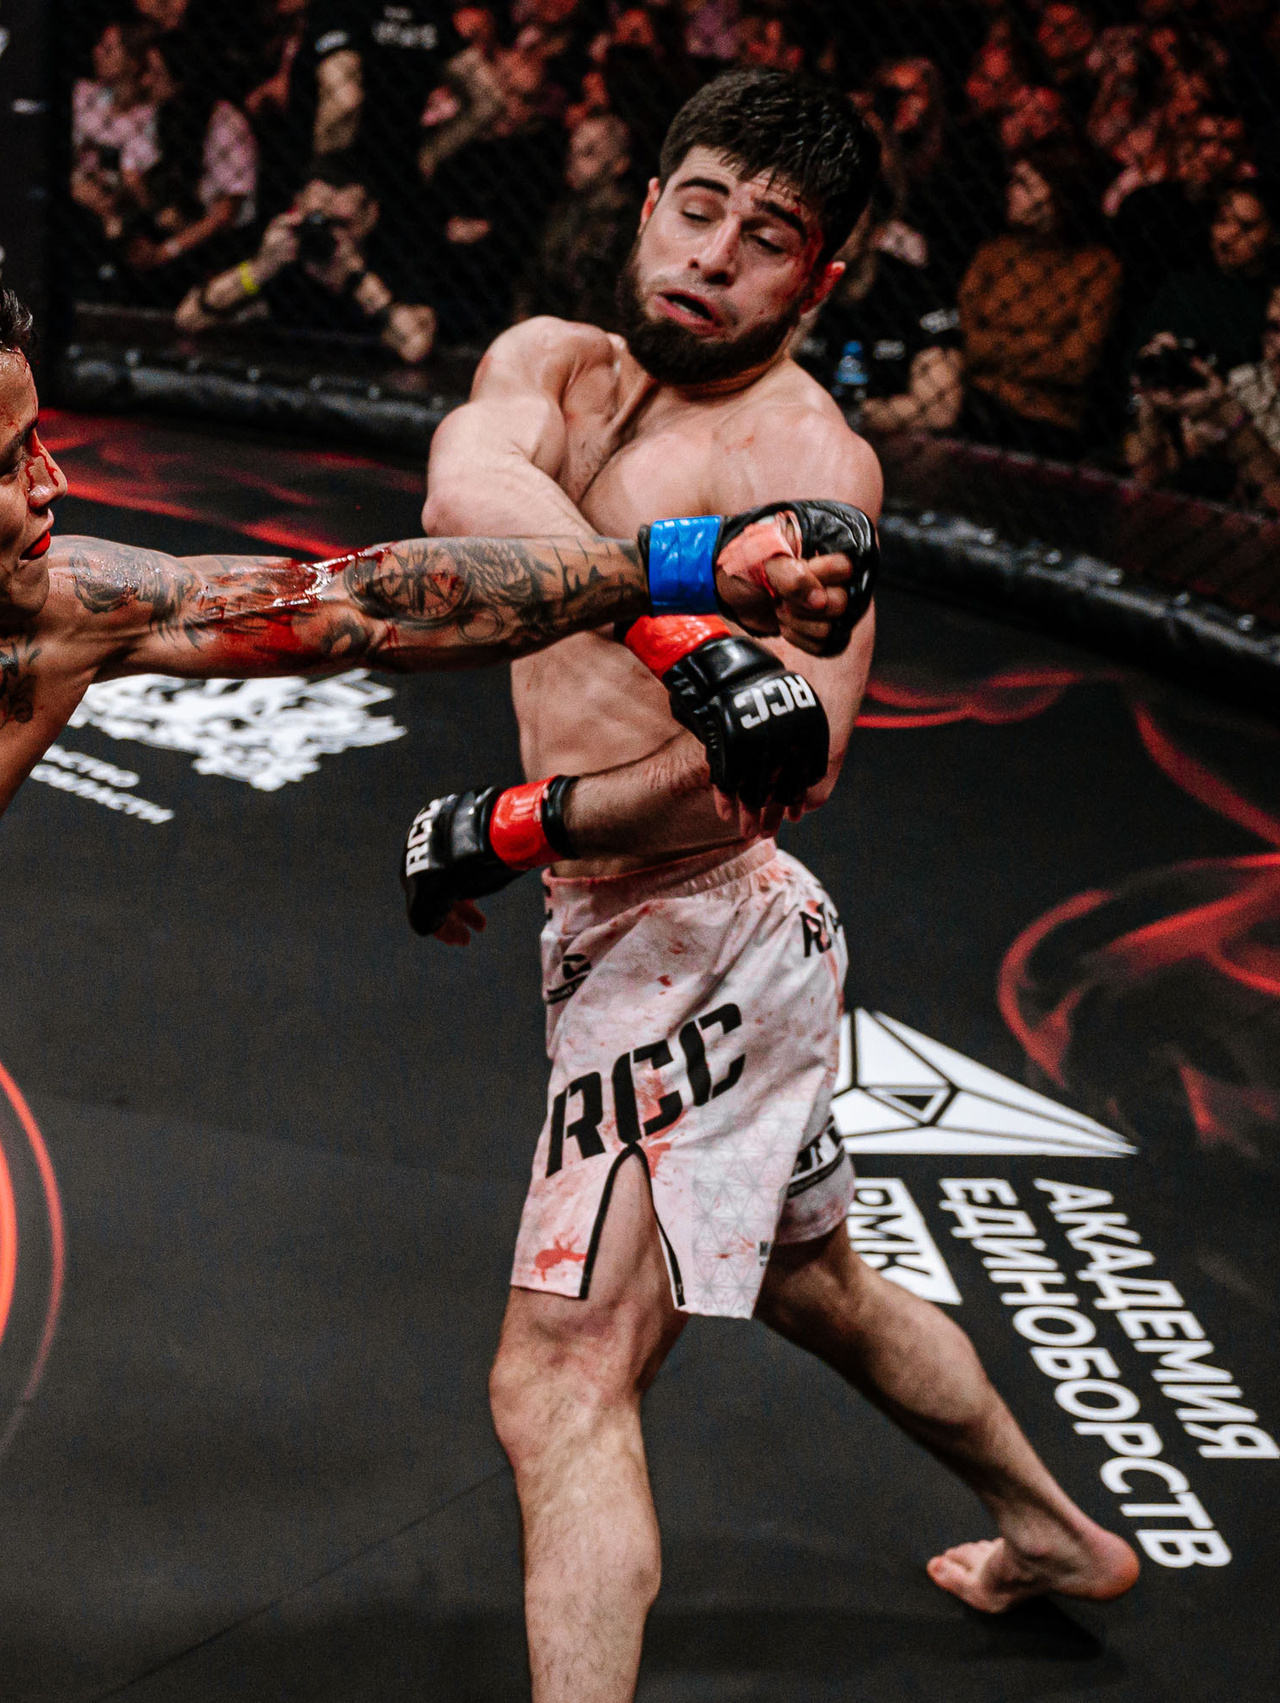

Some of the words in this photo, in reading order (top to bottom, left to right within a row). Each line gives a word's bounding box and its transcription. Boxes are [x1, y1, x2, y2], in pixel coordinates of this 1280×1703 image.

[733, 674, 817, 730] RCC
[545, 1002, 747, 1179] RCC
[938, 1177, 1232, 1568] ЕДИНОБОРСТВ
[1033, 1177, 1280, 1459] АКАДЕМИЯ
